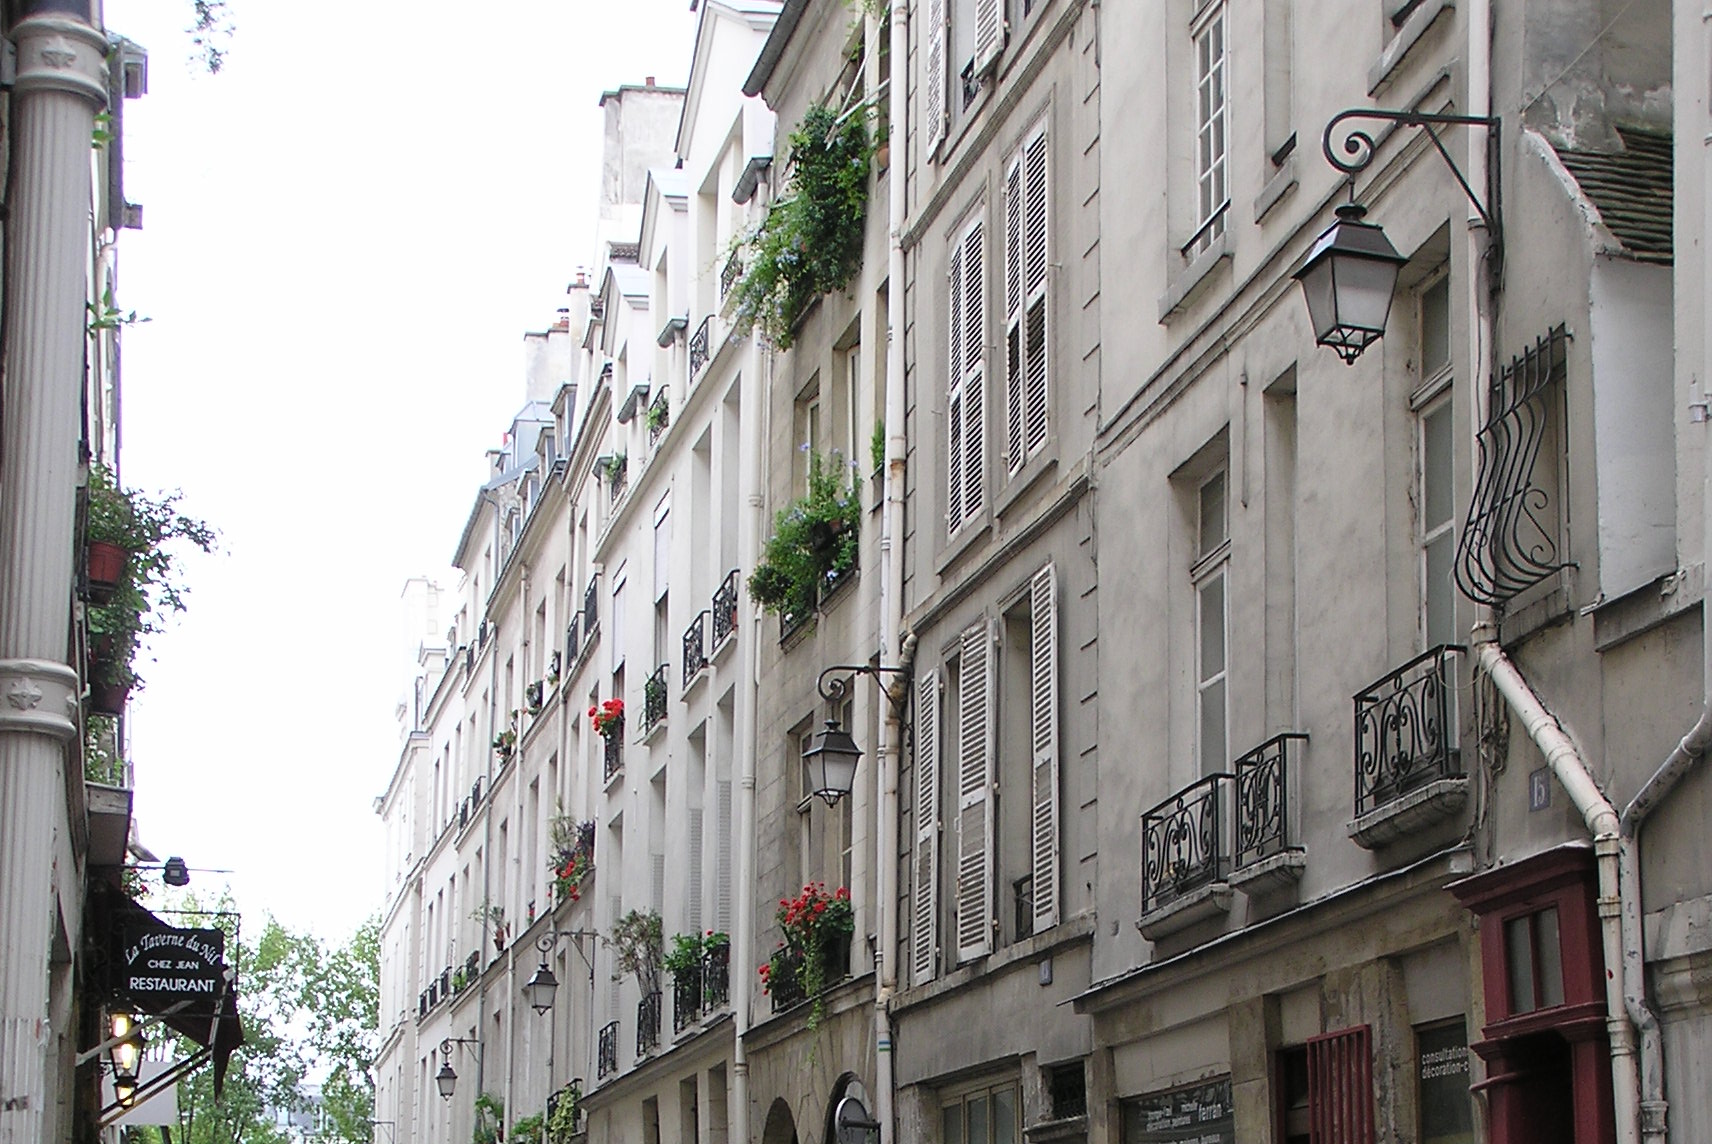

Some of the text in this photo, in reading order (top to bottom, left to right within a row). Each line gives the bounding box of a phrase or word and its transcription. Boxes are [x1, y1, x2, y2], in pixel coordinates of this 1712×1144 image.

[125, 933, 221, 966] La Taverne du Nil
[147, 959, 200, 971] CHEZ JEAN
[129, 977, 216, 993] RESTAURANT
